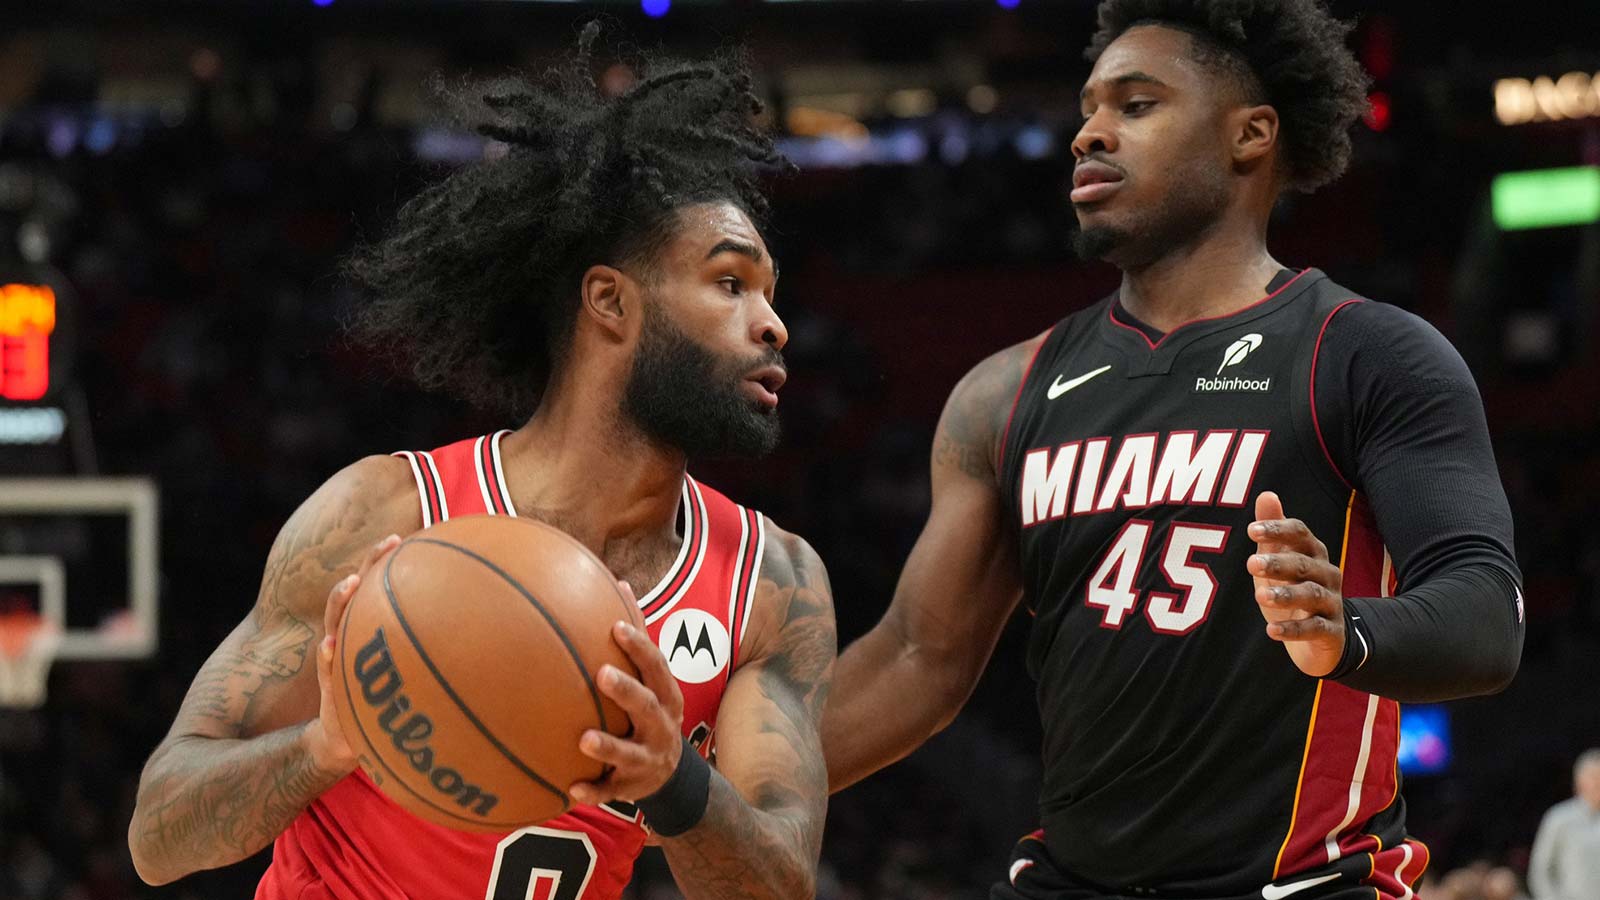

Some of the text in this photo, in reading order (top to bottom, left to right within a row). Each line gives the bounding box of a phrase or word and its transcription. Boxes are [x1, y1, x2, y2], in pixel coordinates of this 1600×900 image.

[1195, 377, 1271, 391] Robinhood
[1021, 429, 1271, 528] MIAMI
[1085, 518, 1232, 636] 45
[355, 625, 499, 816] Wilson
